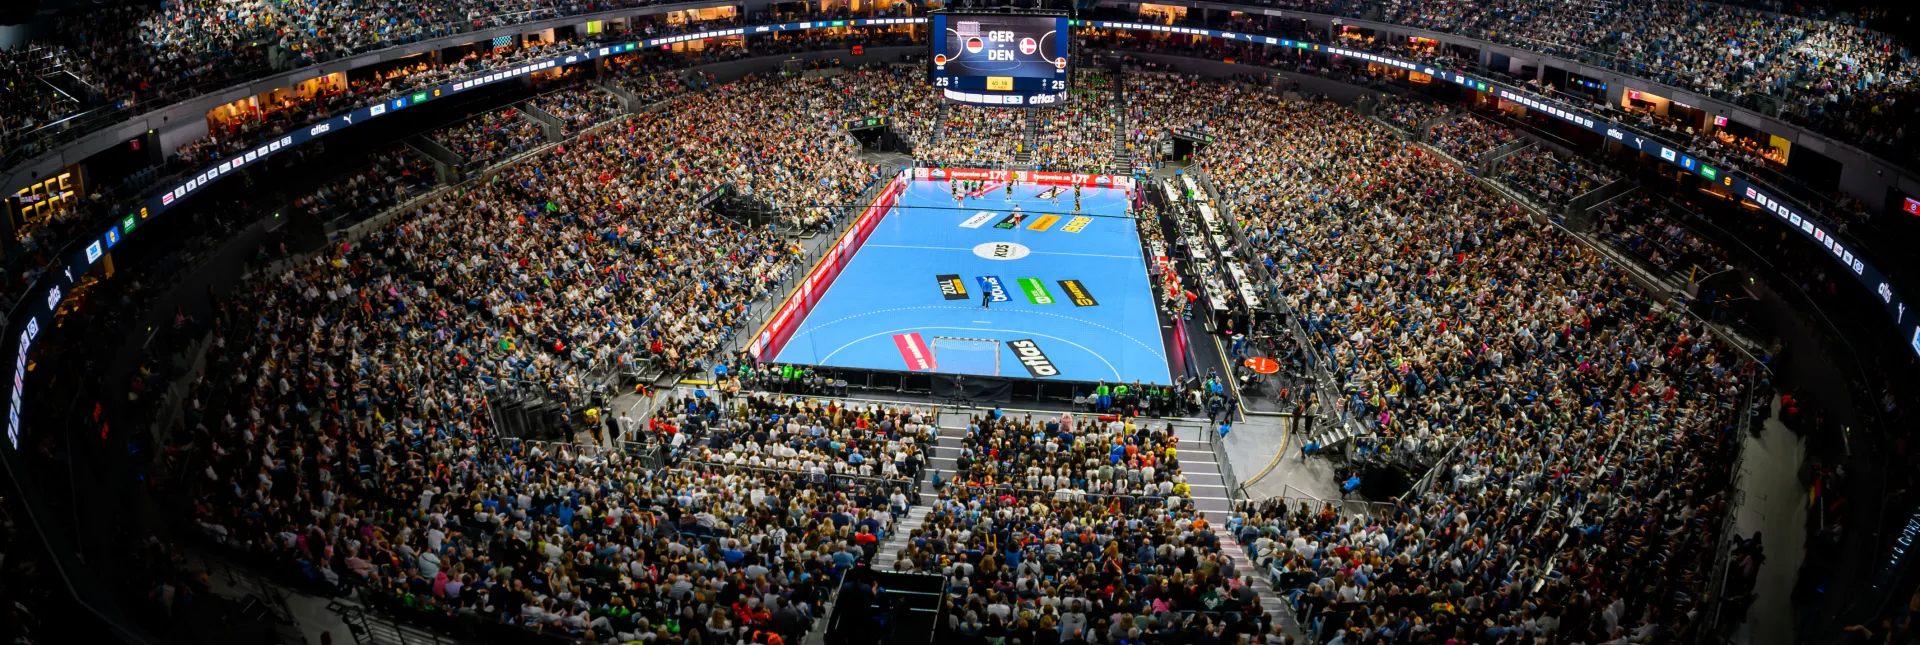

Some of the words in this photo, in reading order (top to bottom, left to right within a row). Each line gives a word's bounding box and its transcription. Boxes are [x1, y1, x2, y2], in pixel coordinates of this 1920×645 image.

[988, 30, 1014, 42] GER
[988, 50, 1014, 61] DEN
[936, 77, 949, 86] 25
[1051, 80, 1065, 90] 25
[1028, 93, 1056, 105] atlas
[310, 123, 330, 136] atlas
[1607, 128, 1624, 140] atlas
[940, 279, 957, 295] ZOLL
[1013, 340, 1057, 376] atlas
